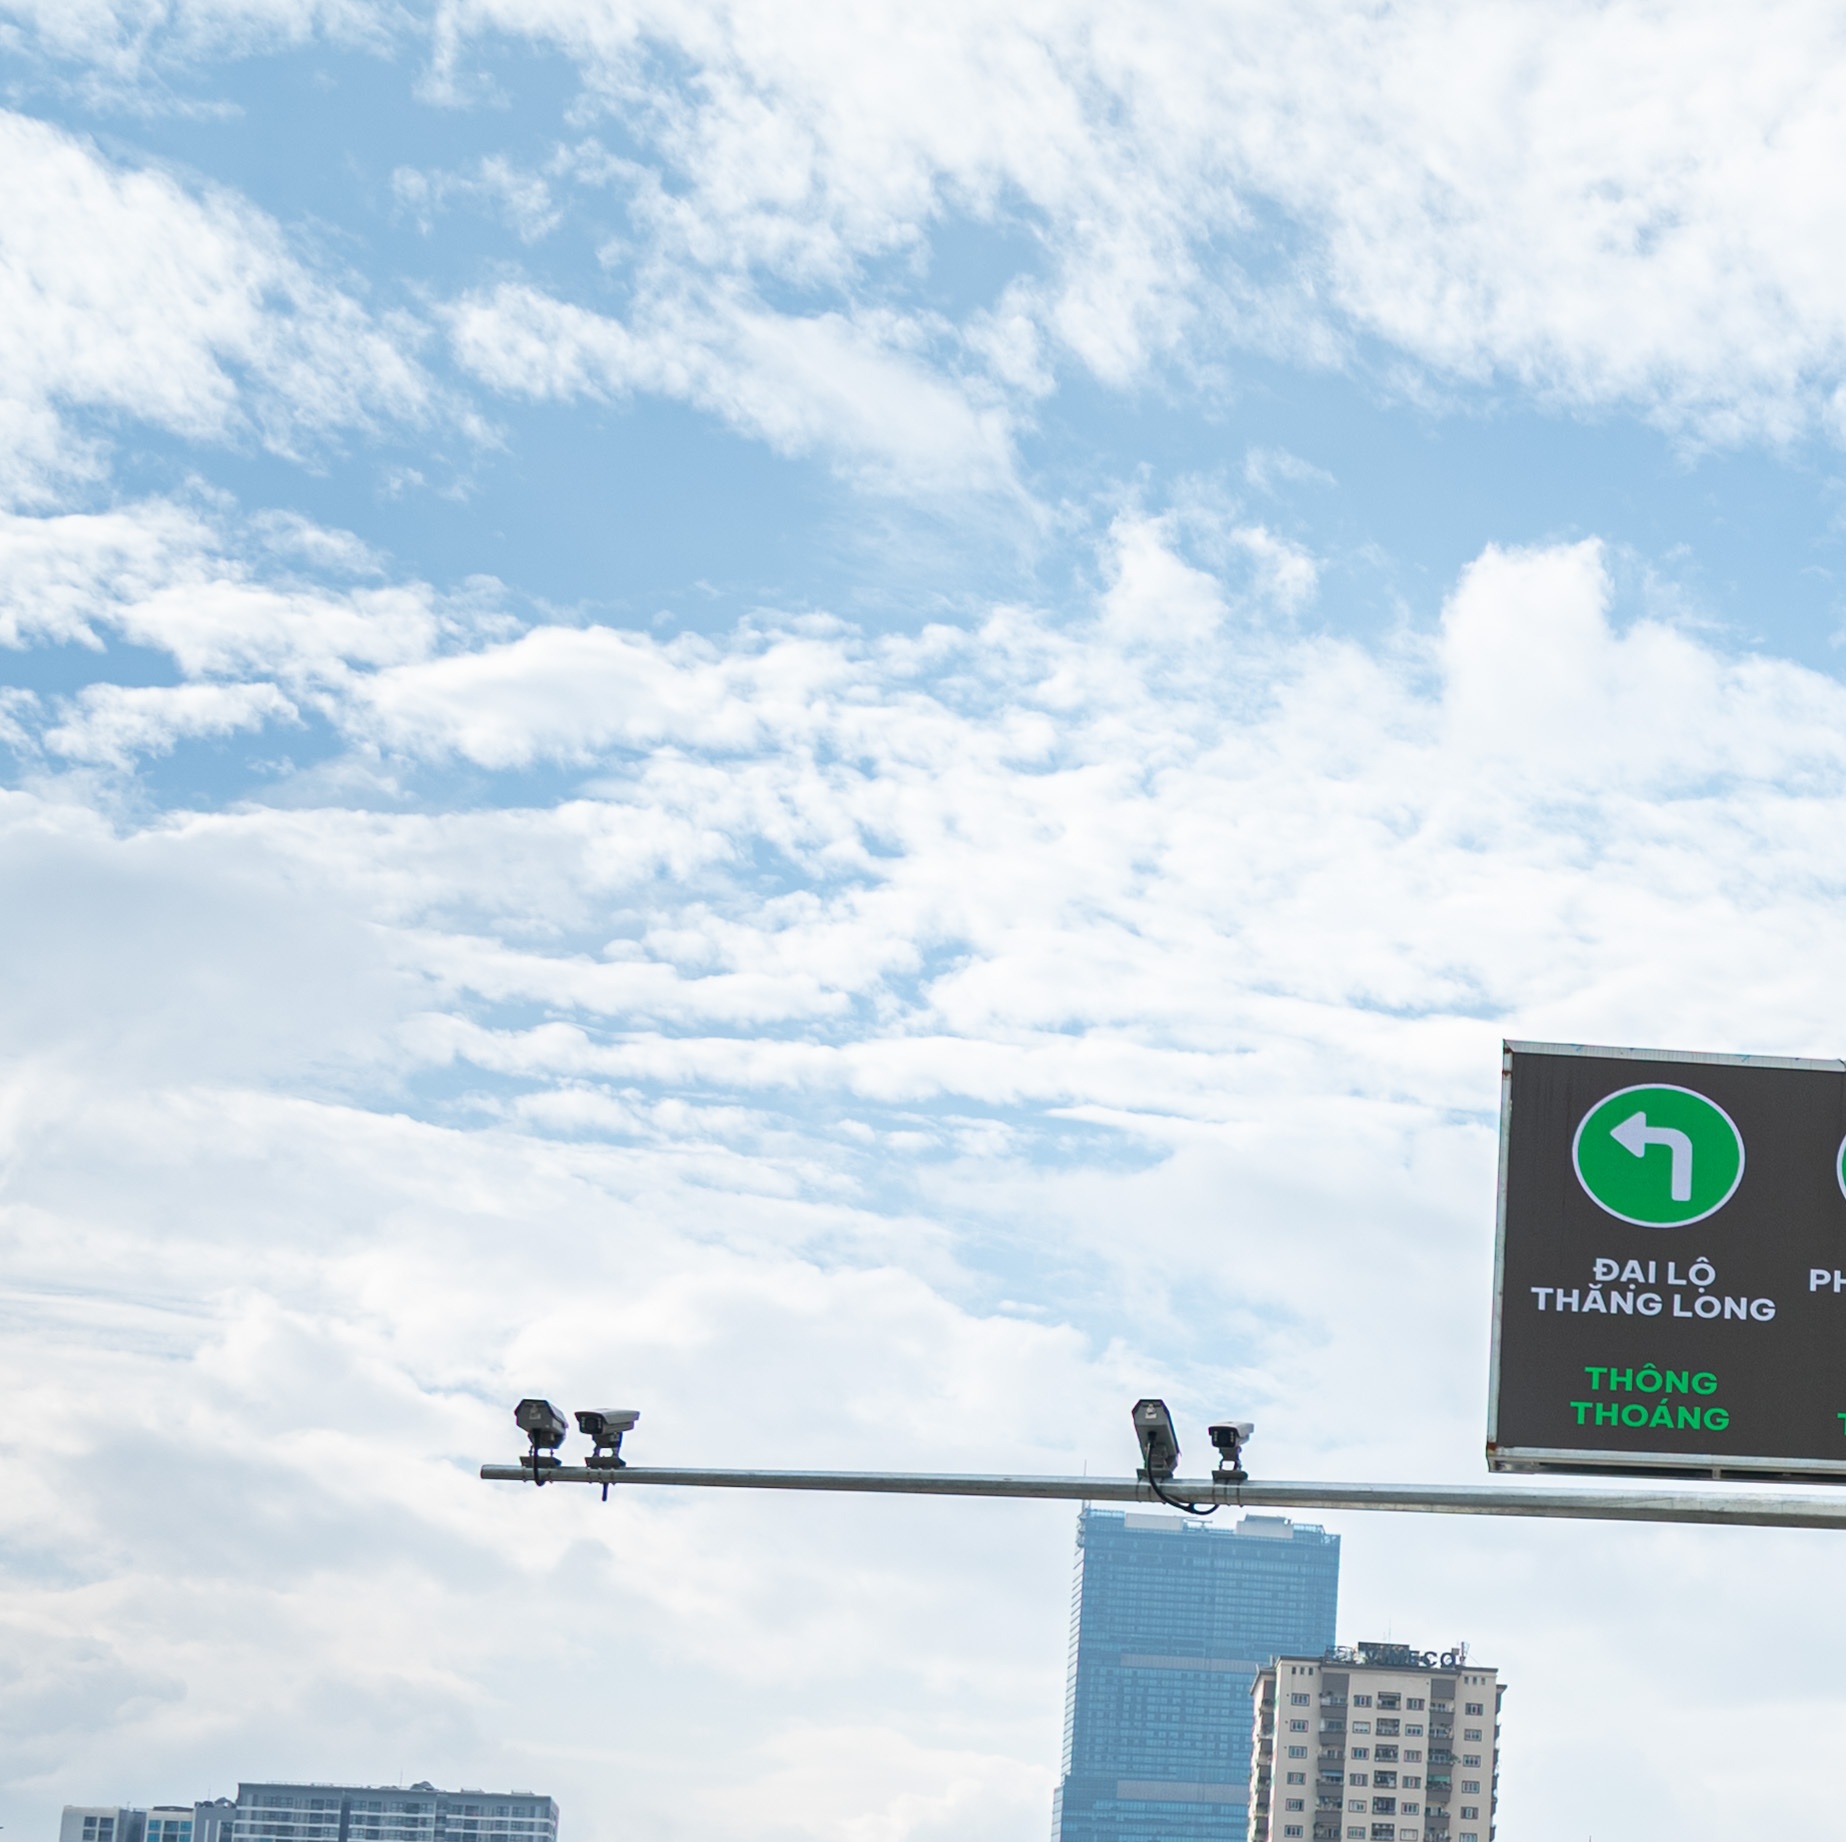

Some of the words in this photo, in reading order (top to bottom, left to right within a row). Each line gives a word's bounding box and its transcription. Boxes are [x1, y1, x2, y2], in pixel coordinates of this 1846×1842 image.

[1593, 1258, 1656, 1290] ĐẠI
[1667, 1256, 1716, 1293] LỘ
[1530, 1283, 1662, 1316] THĂNG
[1673, 1294, 1776, 1321] LONG
[1584, 1363, 1717, 1395] THÔNG
[1570, 1398, 1729, 1431] THOÁNG
